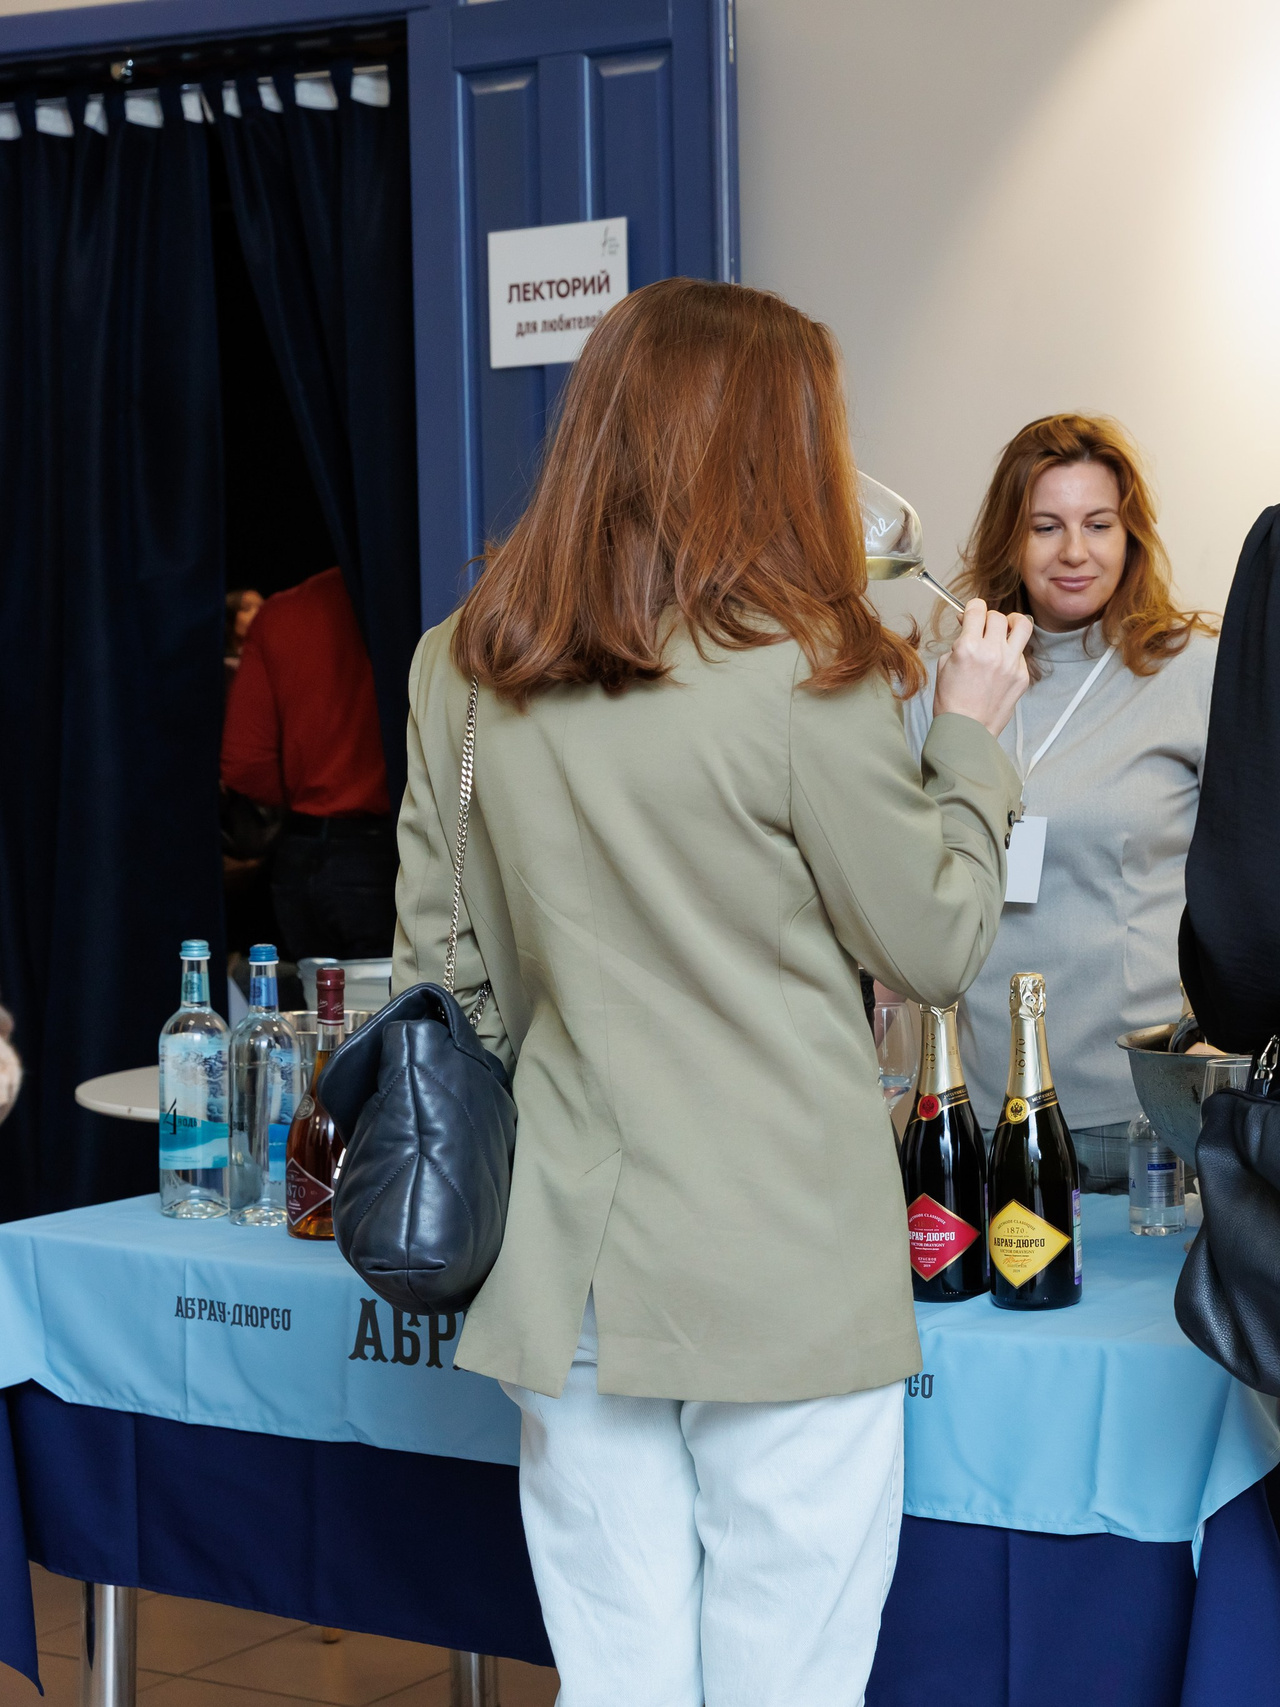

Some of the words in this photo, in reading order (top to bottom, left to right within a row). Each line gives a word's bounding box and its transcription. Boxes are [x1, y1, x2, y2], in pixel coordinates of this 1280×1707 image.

[508, 269, 610, 304] ЛЕКТОРИЙ
[515, 319, 538, 338] для
[287, 1182, 307, 1199] 870
[1006, 1226, 1025, 1234] 1870
[348, 1297, 470, 1372] АБР
